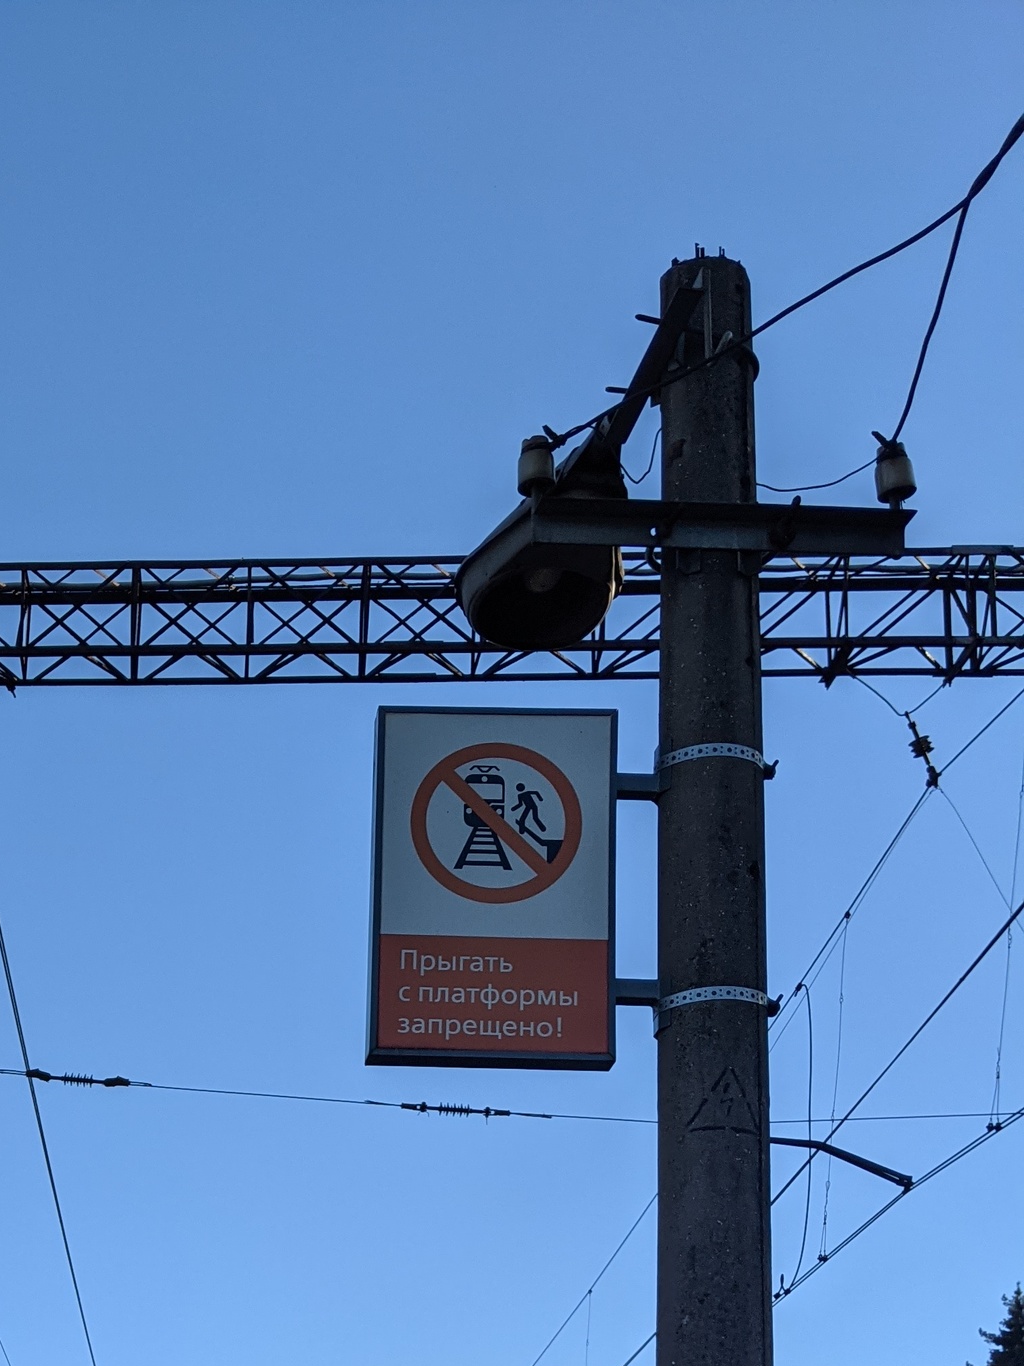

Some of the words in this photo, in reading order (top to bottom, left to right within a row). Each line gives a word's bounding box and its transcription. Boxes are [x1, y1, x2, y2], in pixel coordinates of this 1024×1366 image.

[400, 949, 513, 975] Прыгать
[398, 985, 411, 1002] с
[418, 983, 578, 1010] платформы
[397, 1017, 563, 1040] запрещено!
